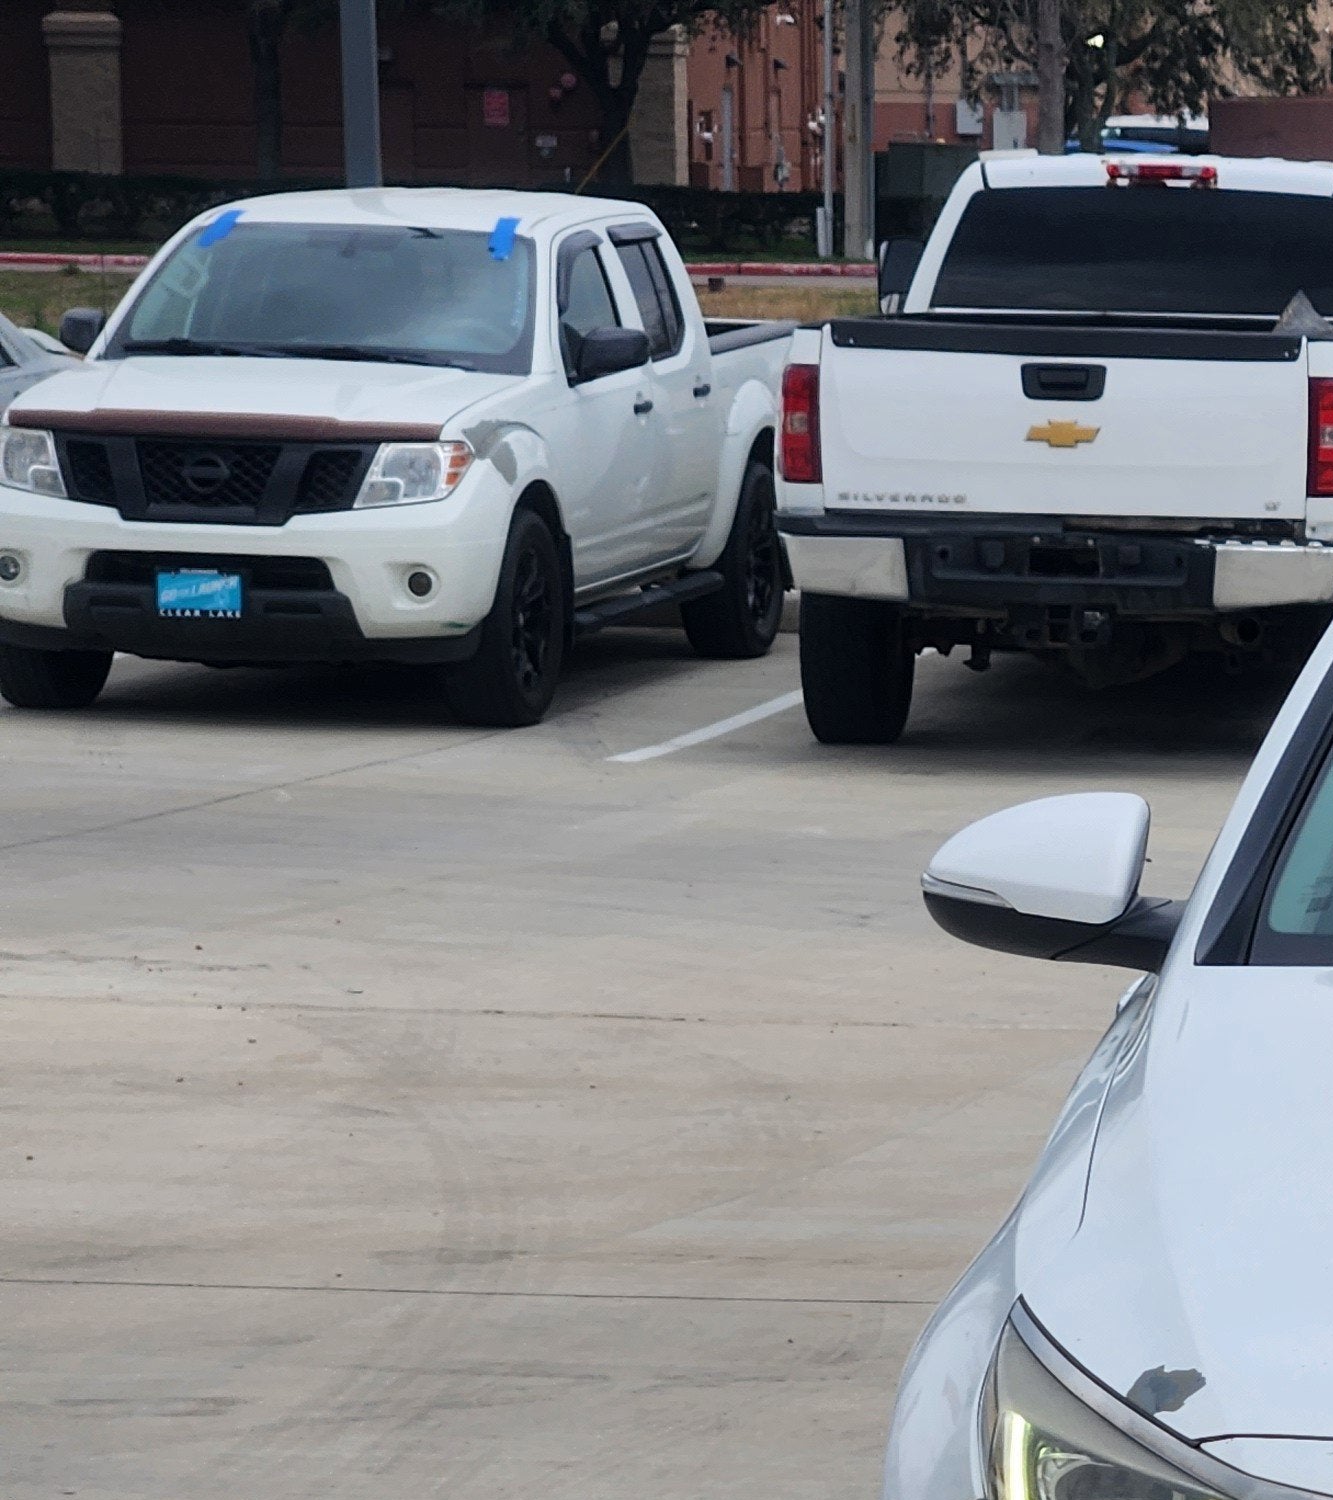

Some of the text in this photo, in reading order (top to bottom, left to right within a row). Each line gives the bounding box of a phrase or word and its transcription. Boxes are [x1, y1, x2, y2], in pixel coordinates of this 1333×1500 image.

[838, 491, 967, 503] SILVERADO
[160, 608, 241, 619] CLEAR LAKE
